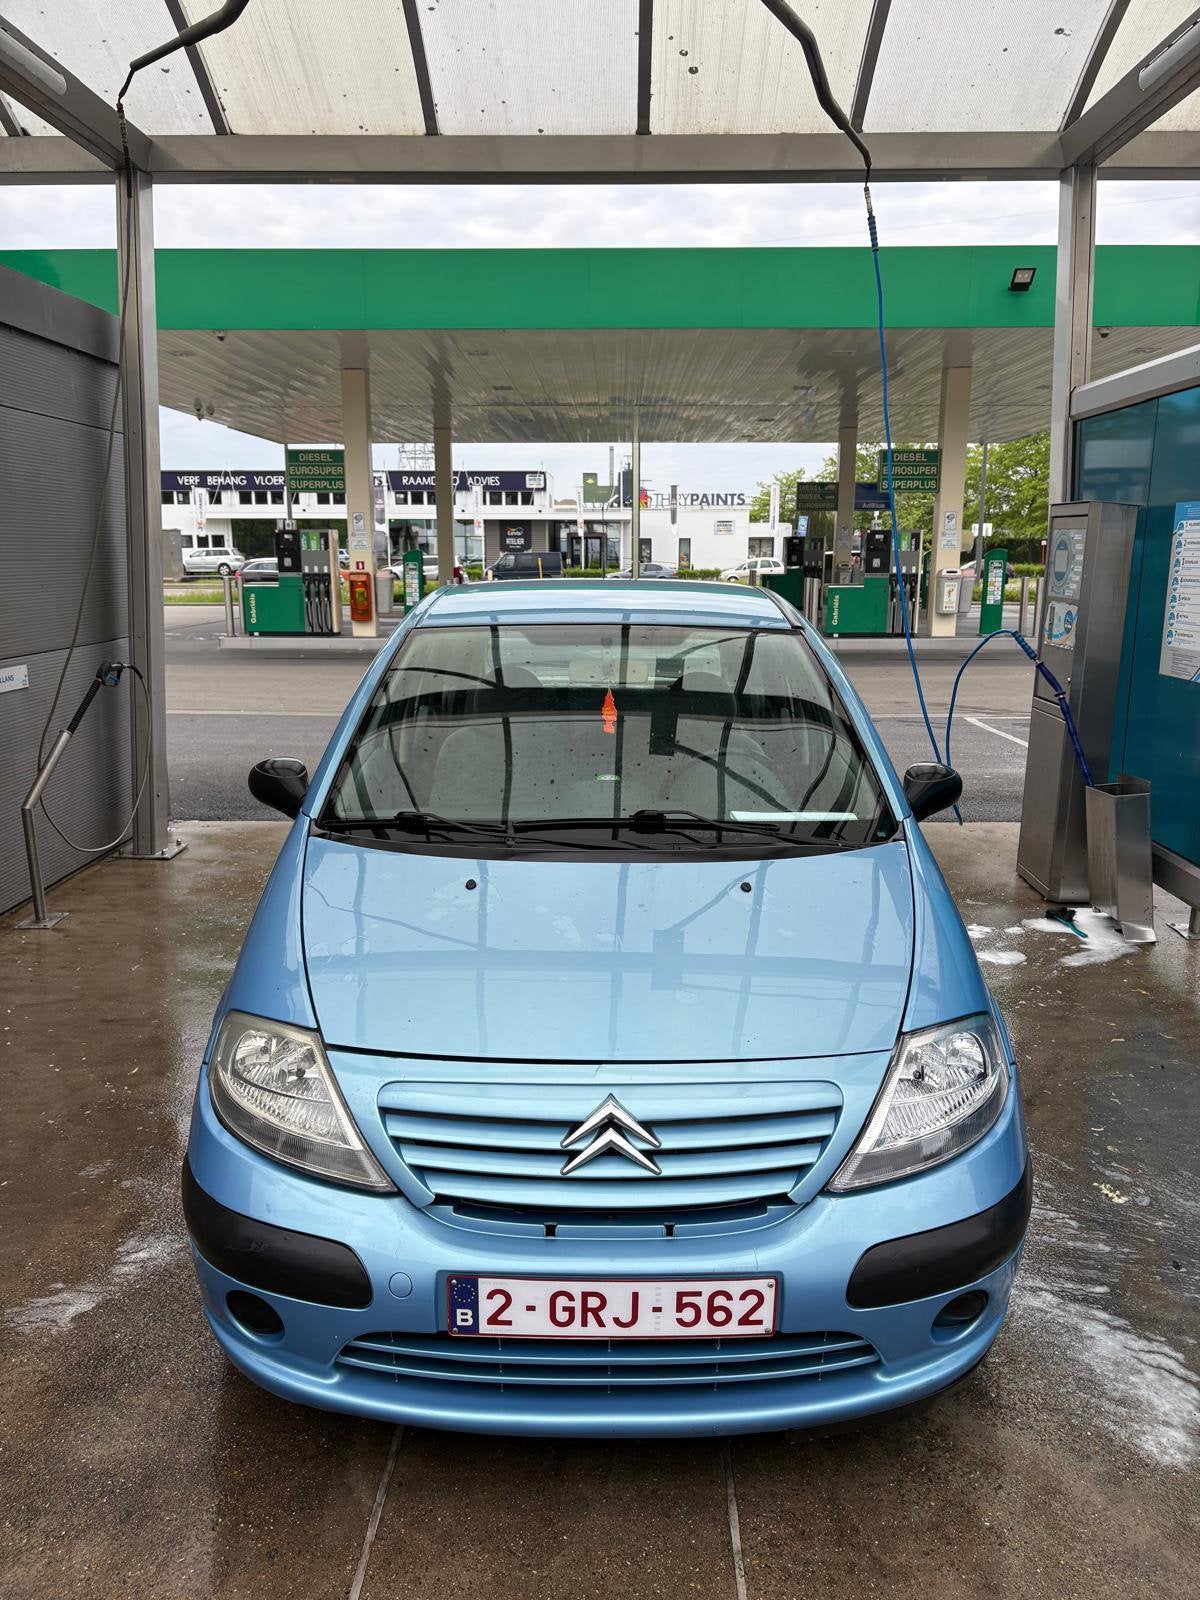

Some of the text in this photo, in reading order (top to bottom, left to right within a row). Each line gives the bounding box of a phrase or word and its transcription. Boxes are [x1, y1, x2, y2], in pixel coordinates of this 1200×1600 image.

[298, 453, 333, 462] DIESEL
[893, 453, 928, 462] DIESEL
[289, 466, 344, 475] EUROSUPER
[177, 475, 284, 485] VERF BEHANG VLOER
[290, 480, 345, 489] SUPERPLUS
[467, 476, 501, 486] ADVIES
[485, 1288, 764, 1329] 2-GRJ-562
[456, 1308, 474, 1326] B
